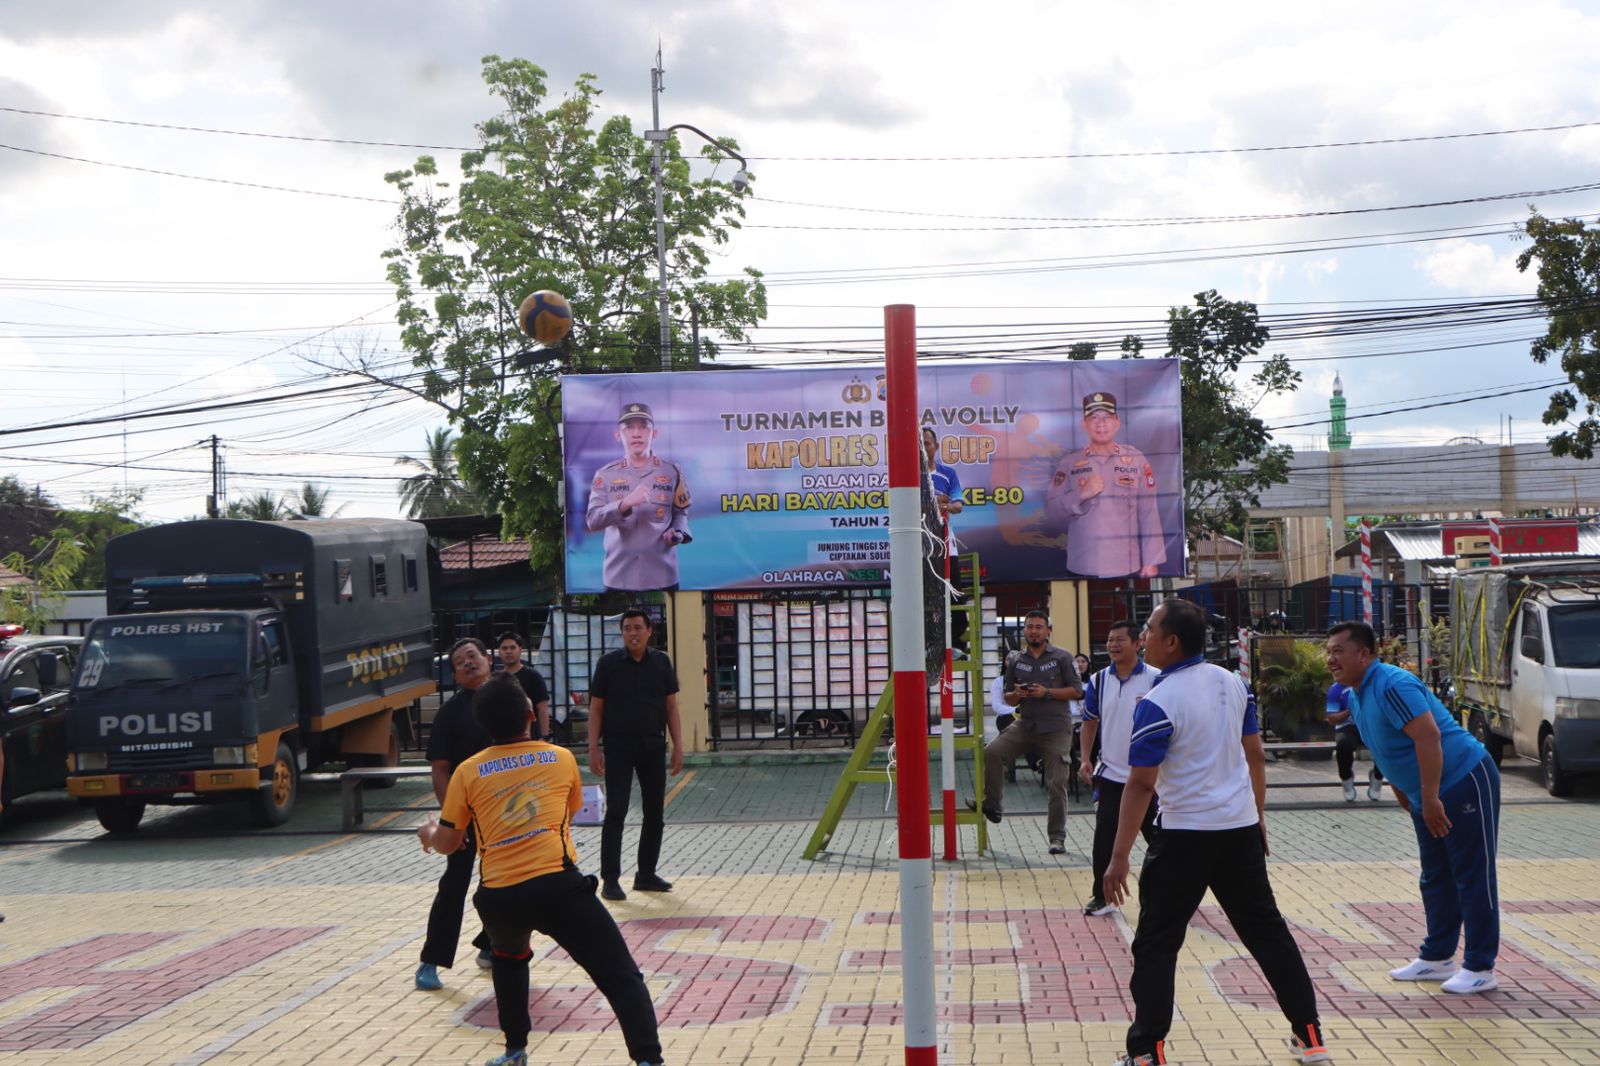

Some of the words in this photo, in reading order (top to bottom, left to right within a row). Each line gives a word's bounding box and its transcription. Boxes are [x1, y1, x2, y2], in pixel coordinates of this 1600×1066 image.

[720, 410, 863, 432] TURNAMEN
[941, 405, 1020, 426] VOLLY
[746, 433, 879, 470] KAPOLRES
[941, 435, 995, 465] CUP
[1114, 466, 1138, 474] POLRI
[801, 475, 863, 489] DALAM
[721, 493, 780, 513] HARI
[830, 517, 879, 528] TAHUN
[817, 542, 850, 552] JUNJUNG
[852, 542, 878, 551] TINGGI
[829, 552, 867, 561] CIPTAKAN
[762, 570, 845, 584] OLAHRAGA
[111, 624, 181, 637] POLRES
[186, 622, 224, 634] HST
[78, 659, 104, 688] 29
[99, 711, 213, 737] POLISI
[121, 741, 193, 752] MITSUBISHI
[477, 755, 519, 777] KAPOLRES
[519, 752, 536, 768] CUP
